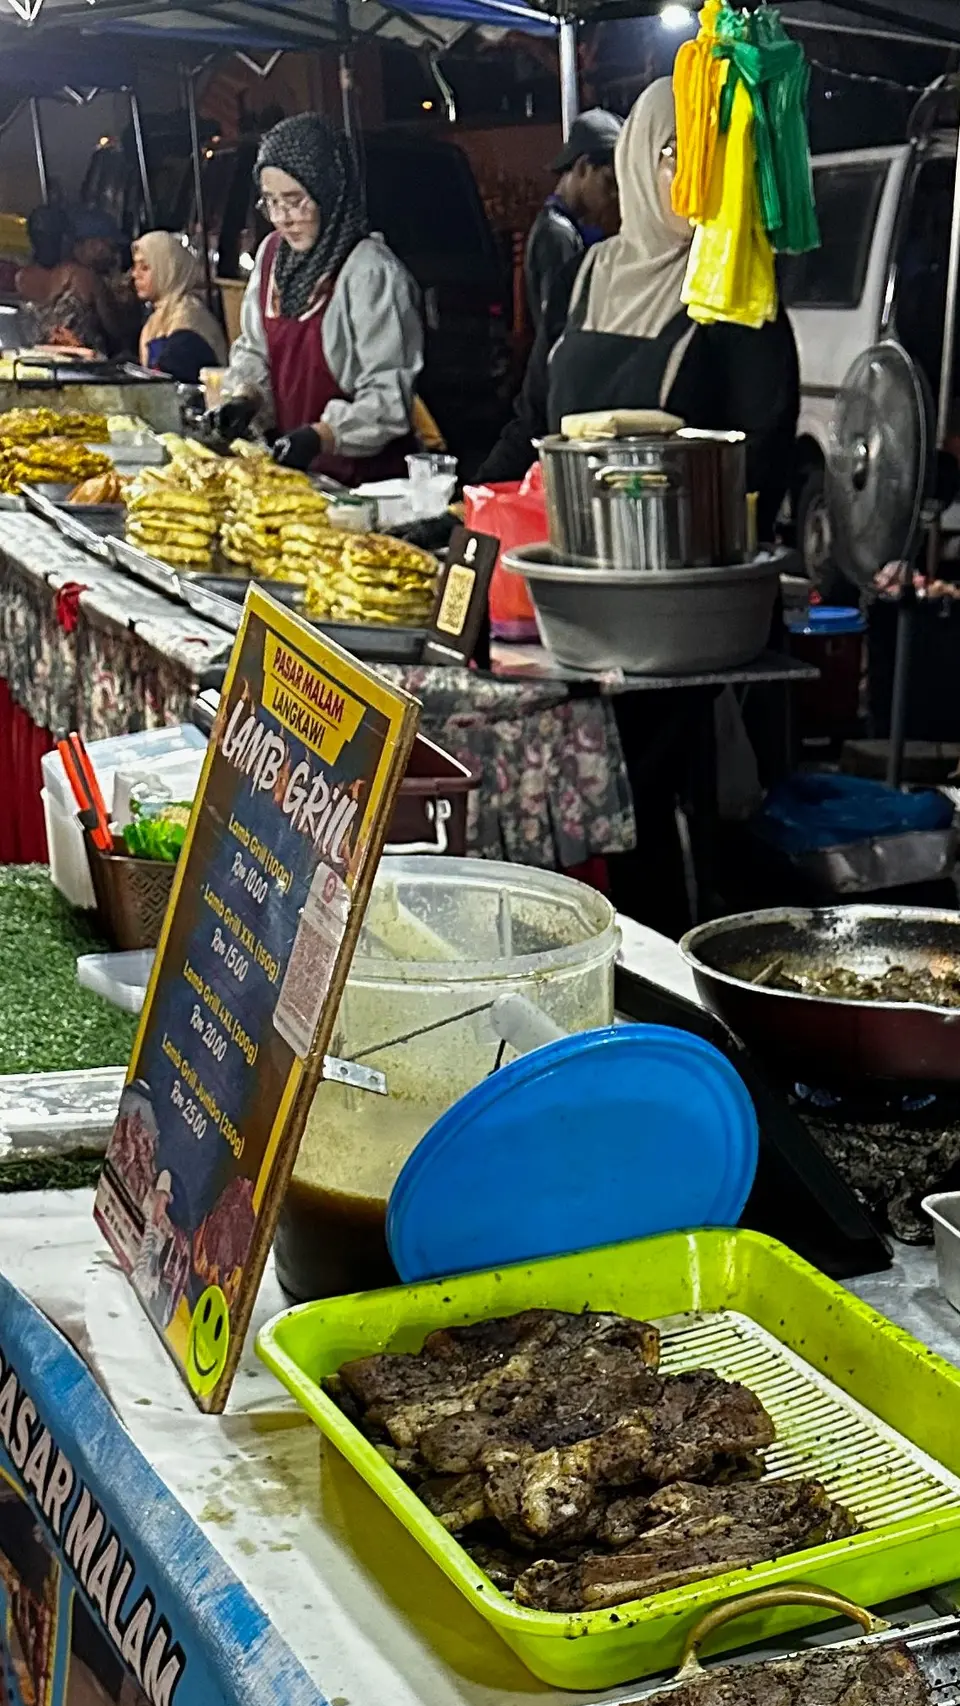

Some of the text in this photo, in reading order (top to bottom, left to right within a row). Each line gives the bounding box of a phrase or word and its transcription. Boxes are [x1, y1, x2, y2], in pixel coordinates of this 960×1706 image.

[273, 647, 346, 722] PASAR MALAM
[222, 700, 286, 797] LAMB
[272, 687, 326, 750] LANGKAWI
[228, 812, 250, 847] Lamb
[250, 836, 268, 865] Grill
[204, 883, 225, 917] Lamb
[224, 907, 241, 937] Grill
[240, 923, 256, 954] XXL
[183, 959, 204, 995] Lamb
[203, 985, 221, 1015] Grill
[162, 1032, 182, 1068] Lamb
[181, 1059, 198, 1090] Grill
[0, 1357, 75, 1537] ASAR
